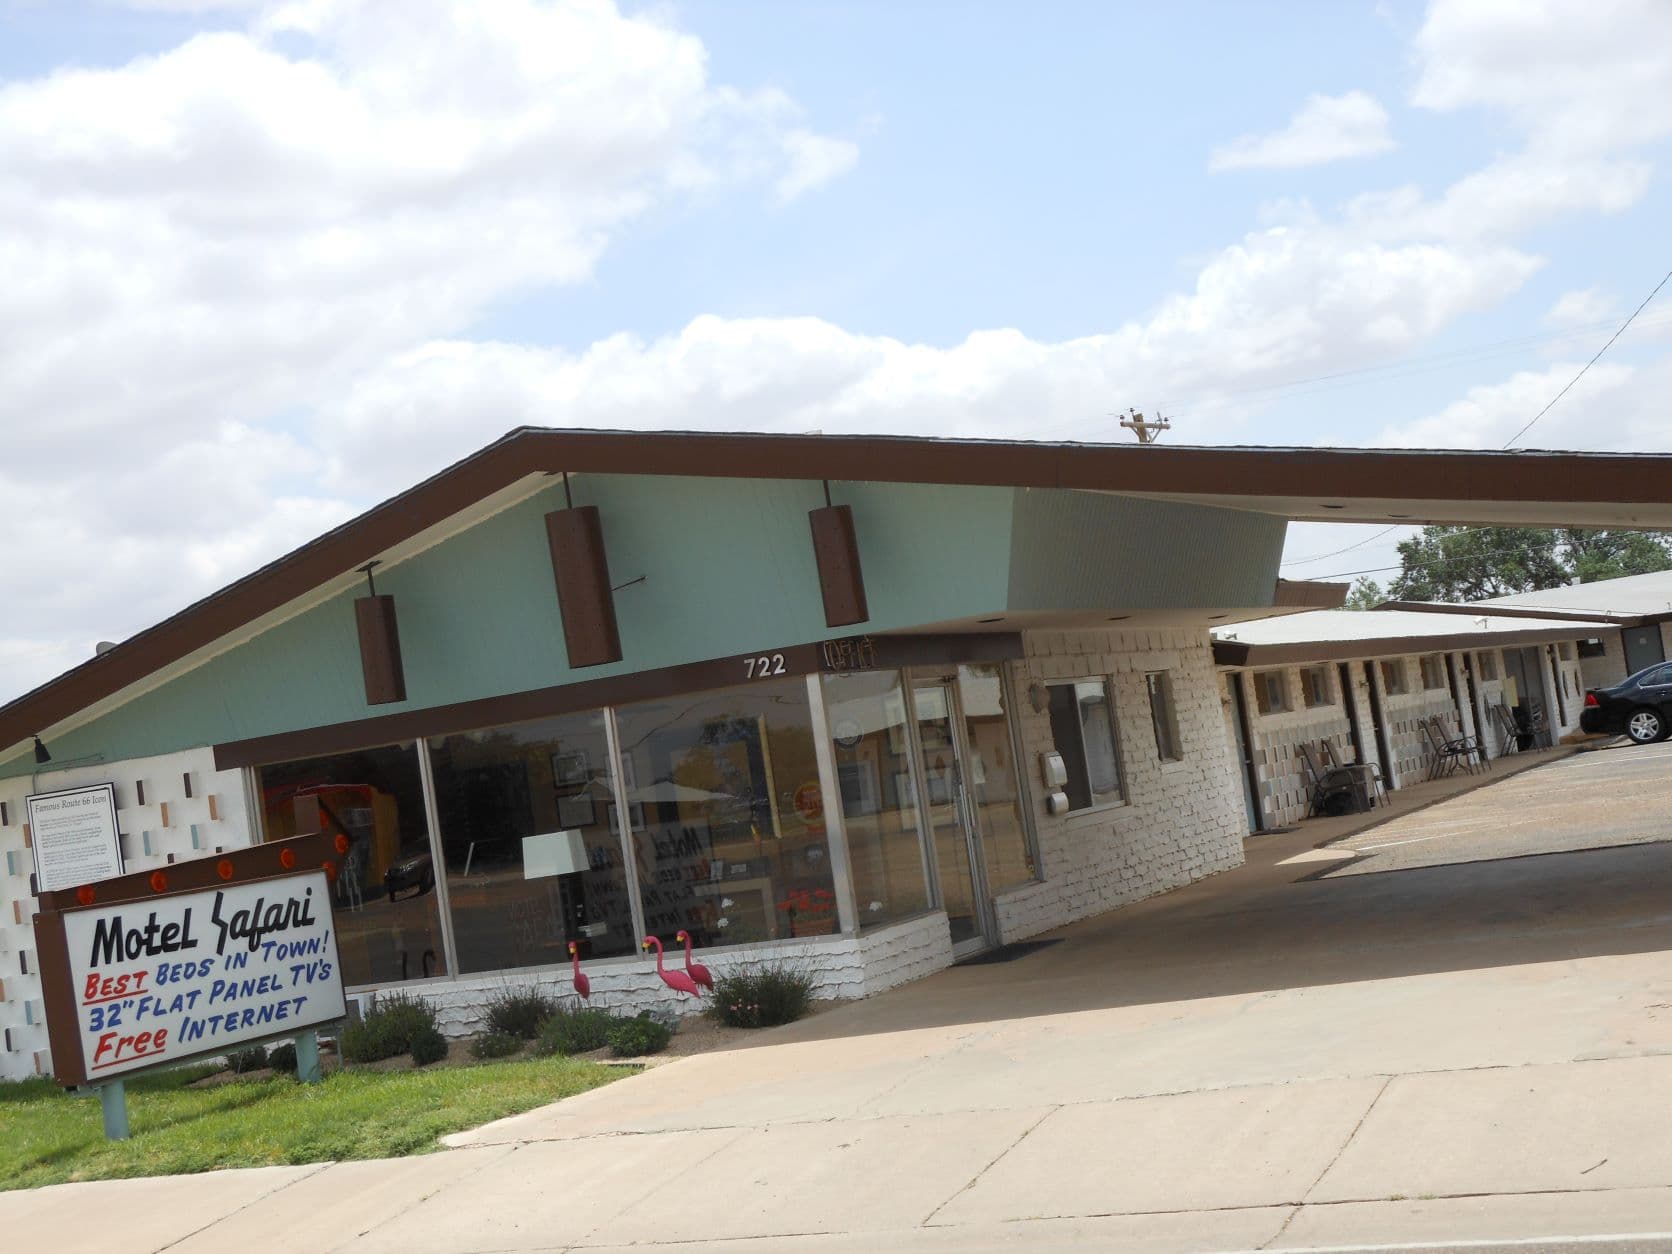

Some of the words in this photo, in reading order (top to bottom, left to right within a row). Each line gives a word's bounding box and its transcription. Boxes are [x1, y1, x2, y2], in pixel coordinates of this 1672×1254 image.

[743, 653, 787, 679] 722
[35, 802, 60, 814] Famous
[61, 799, 81, 809] Route
[82, 796, 91, 806] 66
[90, 908, 198, 968] Motel
[211, 887, 316, 957] Safari
[83, 970, 149, 1002] BEST
[155, 958, 216, 986] BEDS
[224, 952, 249, 971] IN
[260, 929, 330, 962] TOWN!
[135, 989, 202, 1021] FLAT
[208, 974, 284, 1005] PANEL
[93, 1028, 169, 1064] Free
[178, 996, 308, 1044] INTERNET
